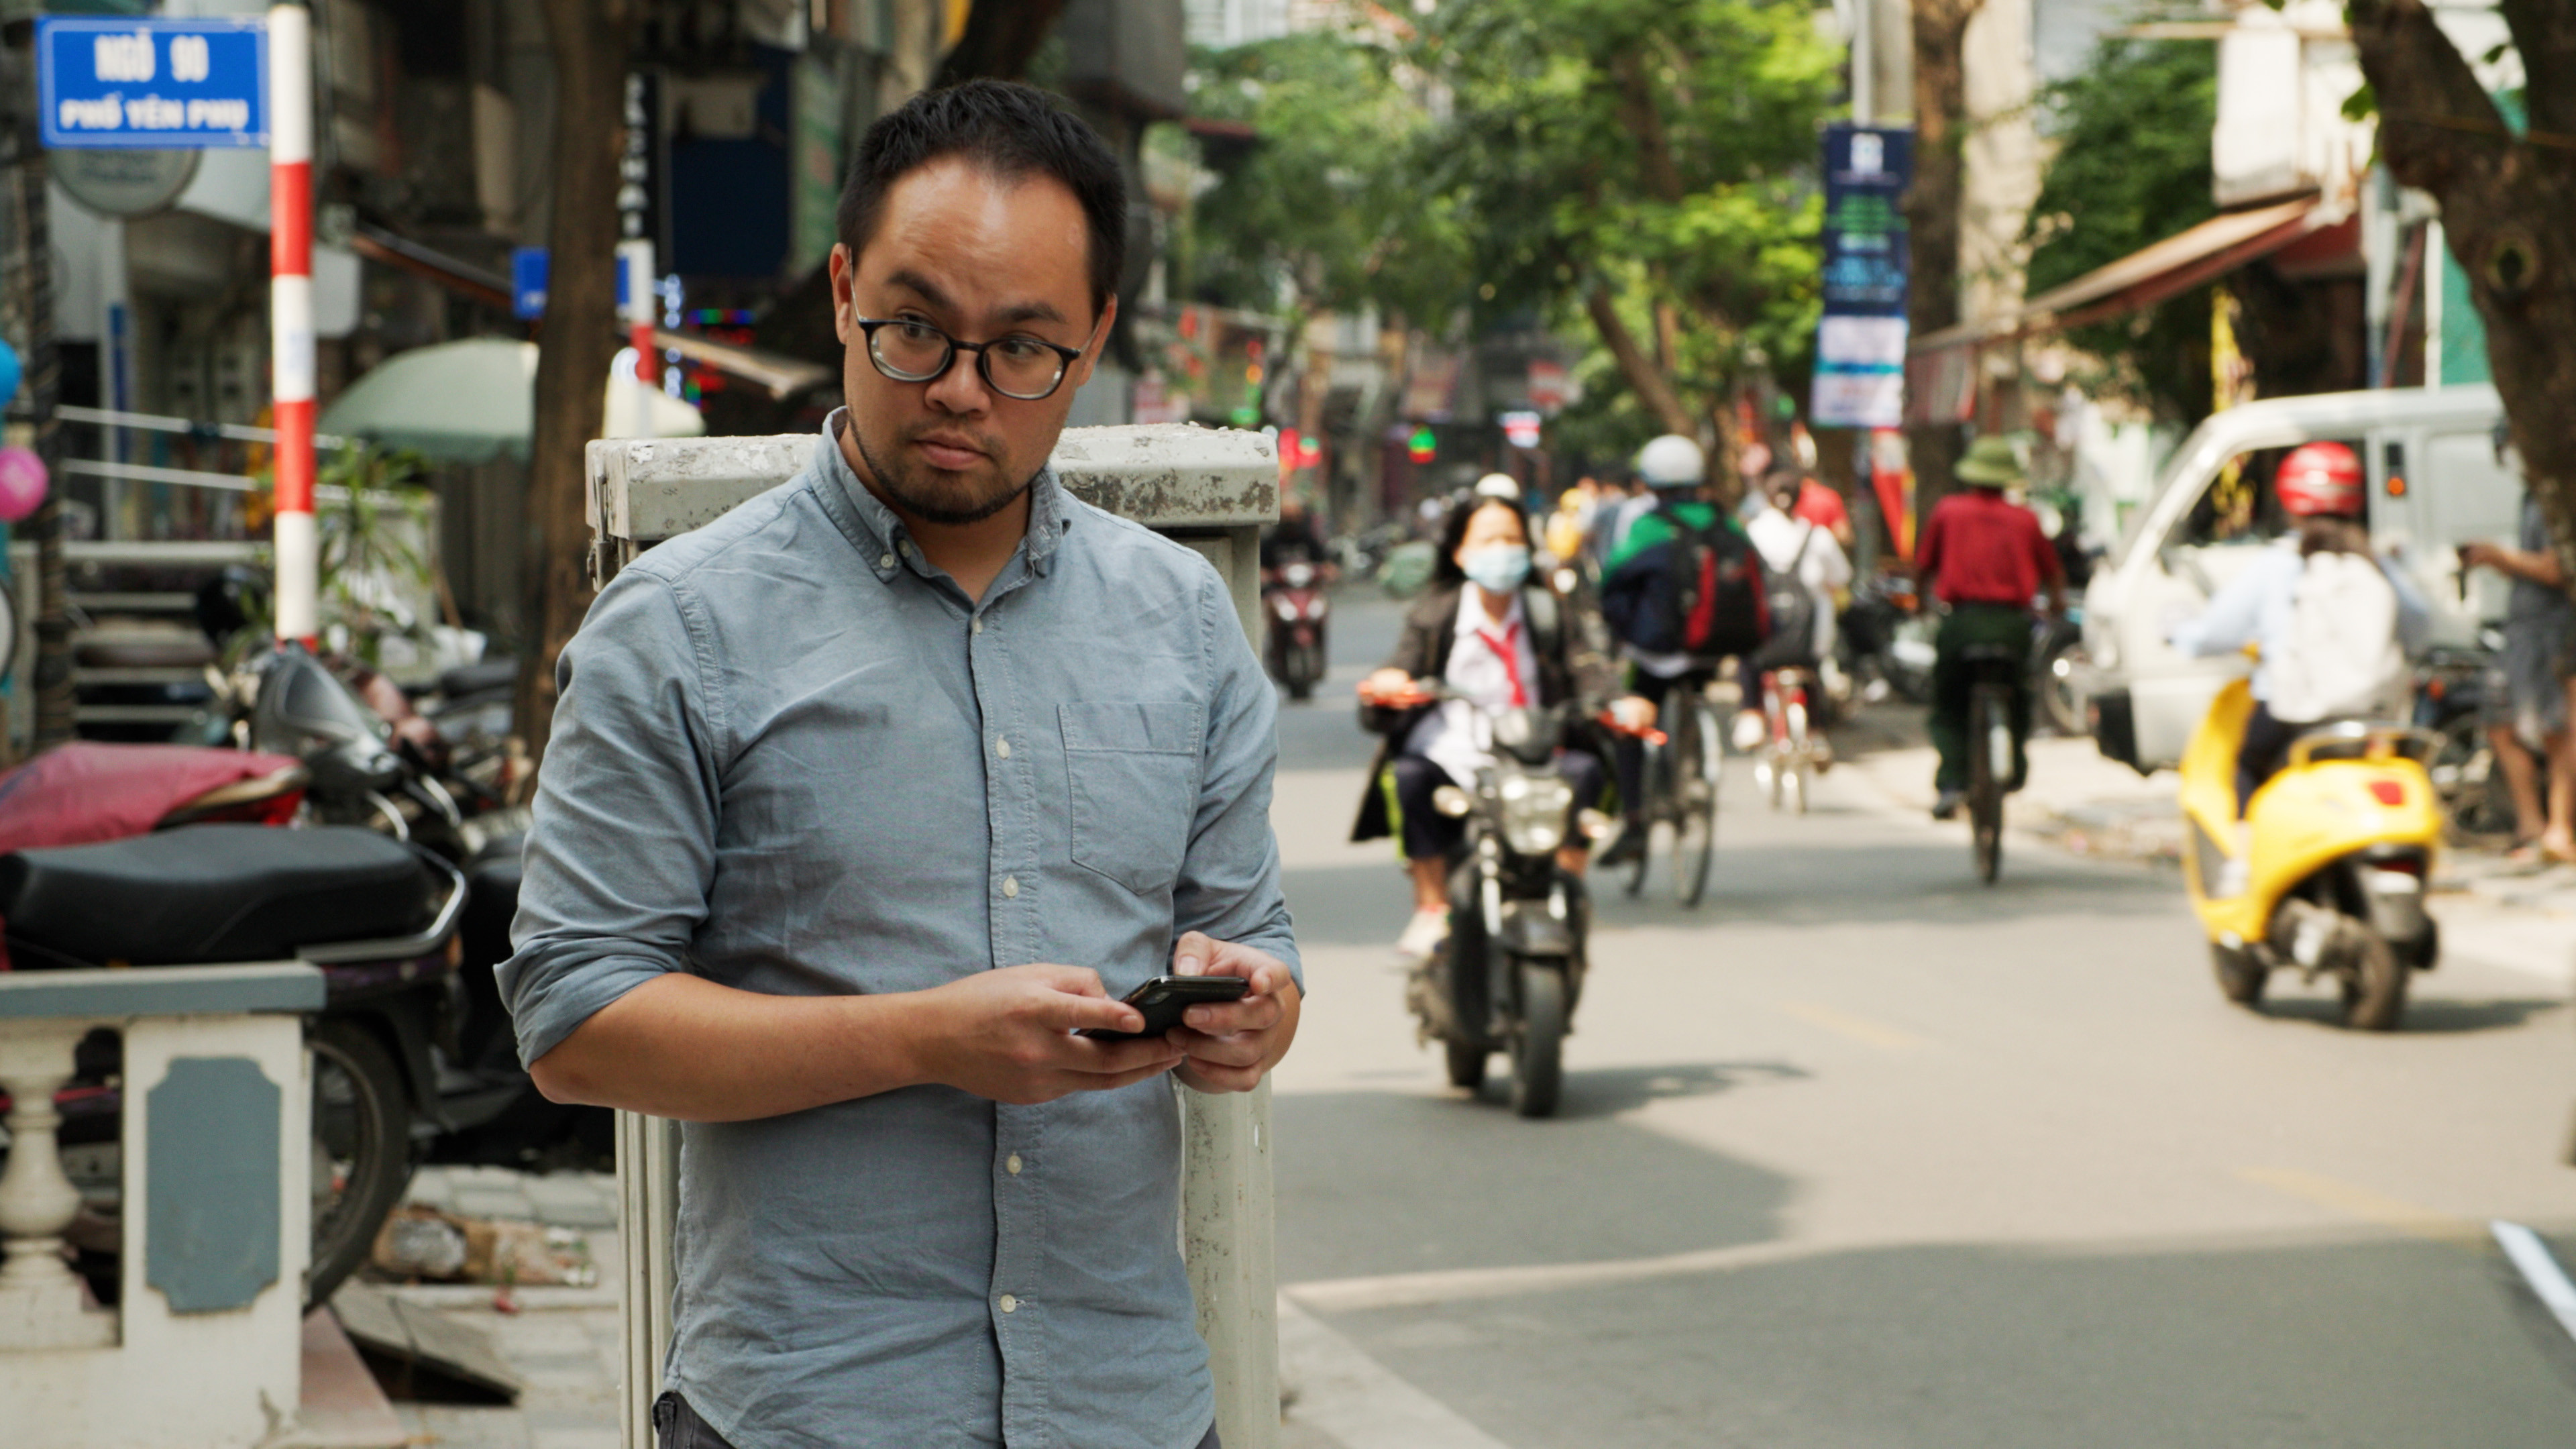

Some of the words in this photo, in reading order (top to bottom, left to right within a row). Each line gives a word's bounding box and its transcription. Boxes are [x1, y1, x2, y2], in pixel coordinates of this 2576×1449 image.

[170, 35, 209, 82] 90
[60, 91, 122, 129] PHỐ
[125, 93, 184, 129] YÊN
